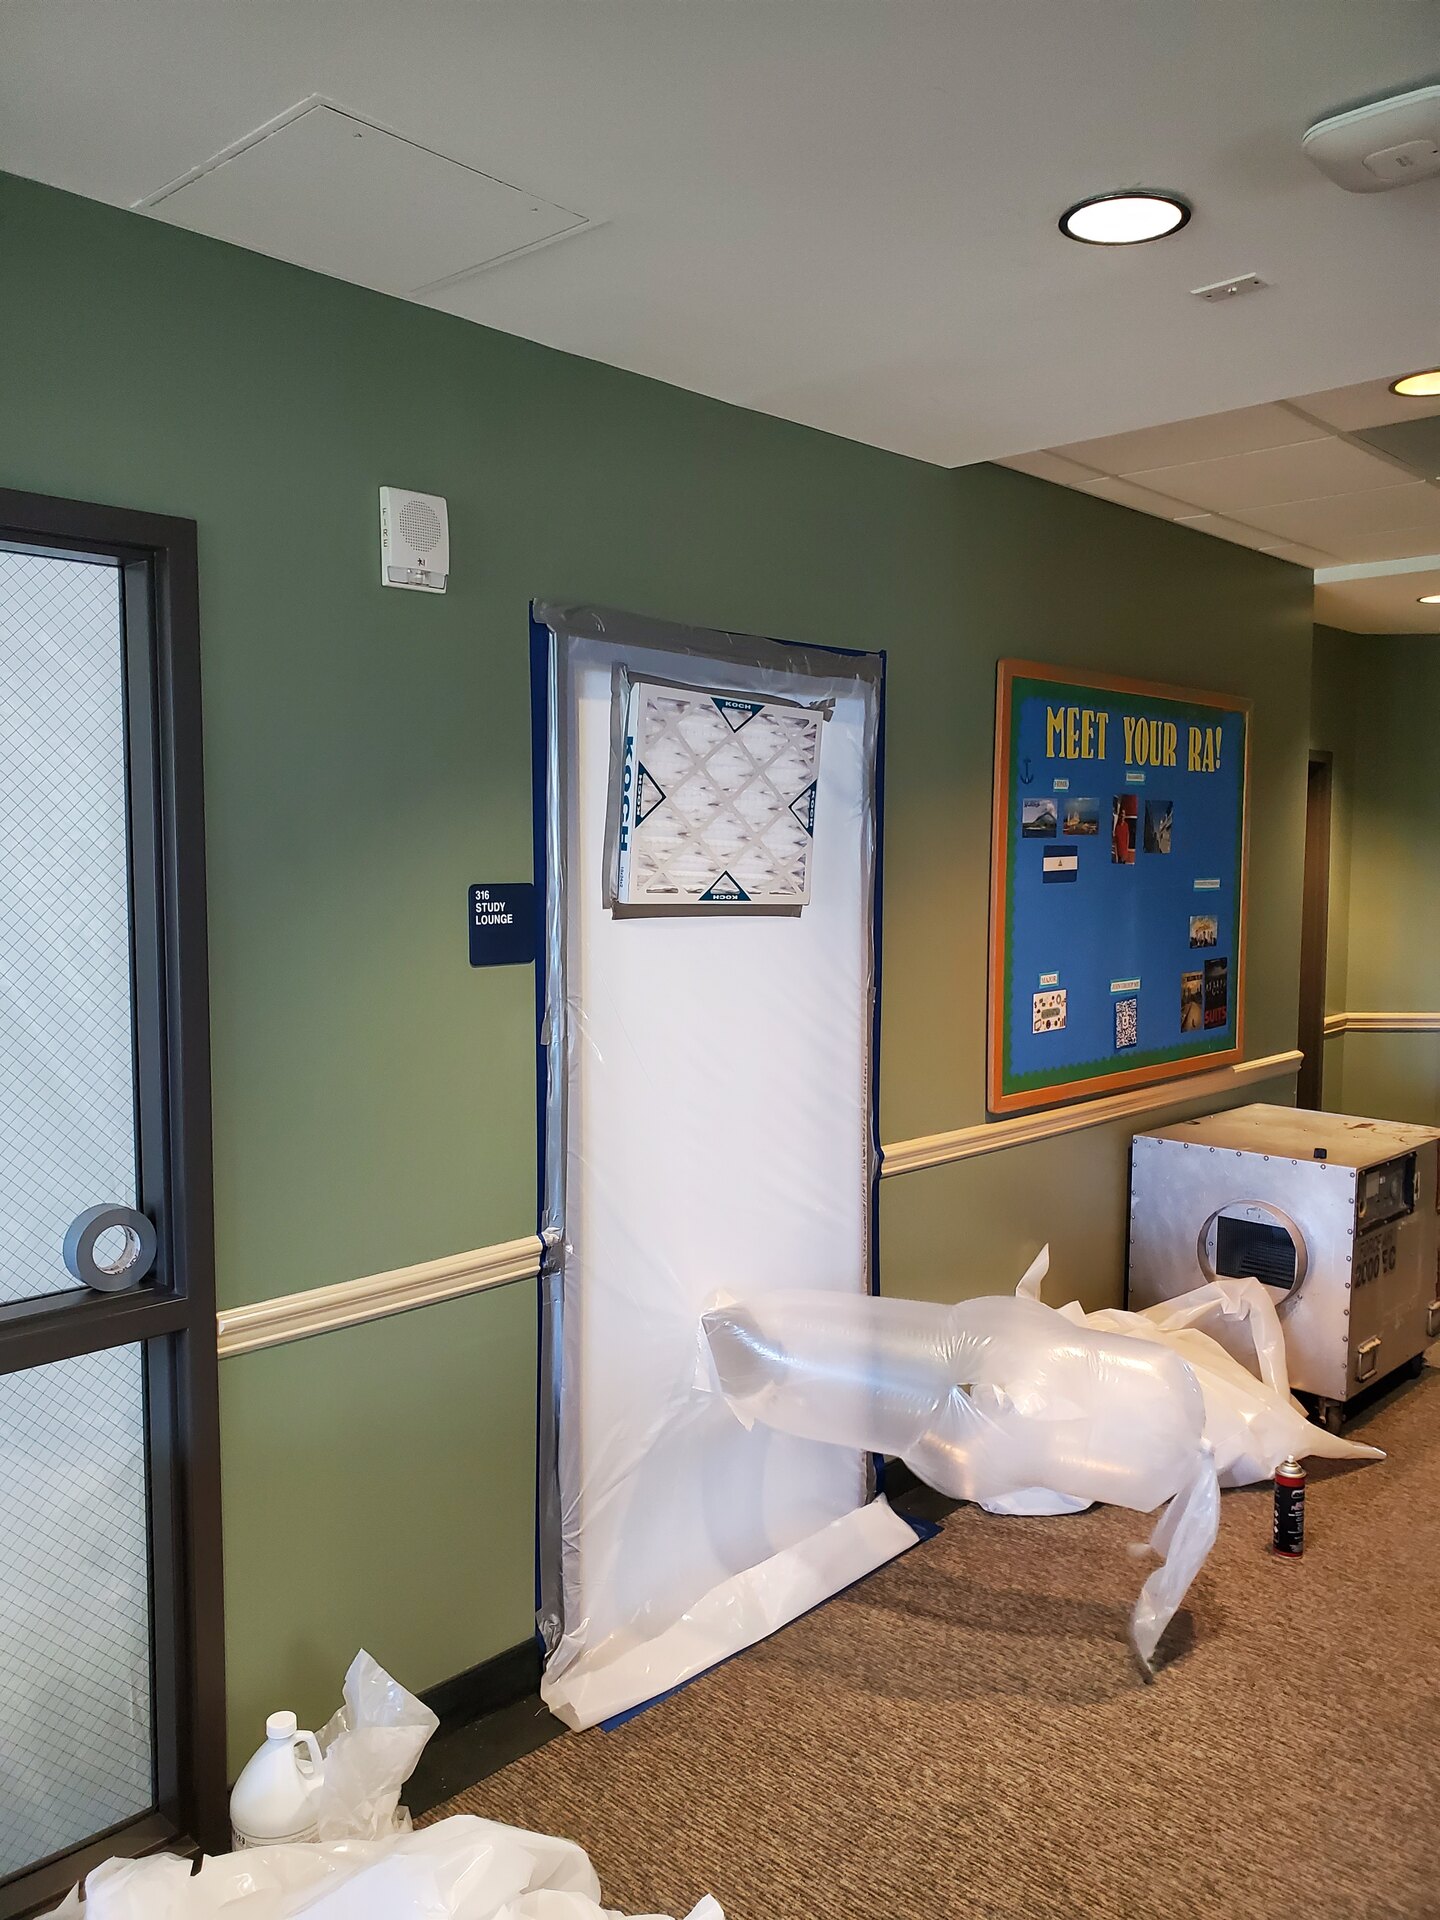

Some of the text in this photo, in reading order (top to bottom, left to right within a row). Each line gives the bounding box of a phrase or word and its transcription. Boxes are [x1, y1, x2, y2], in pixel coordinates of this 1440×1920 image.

[725, 700, 752, 710] KOCH
[1046, 706, 1223, 773] MEET YOUR RA!
[620, 736, 634, 852] KOCH
[475, 890, 490, 900] 316
[475, 902, 506, 913] STUDY
[475, 914, 513, 925] LOUNGE
[1204, 1007, 1227, 1026] SUITS
